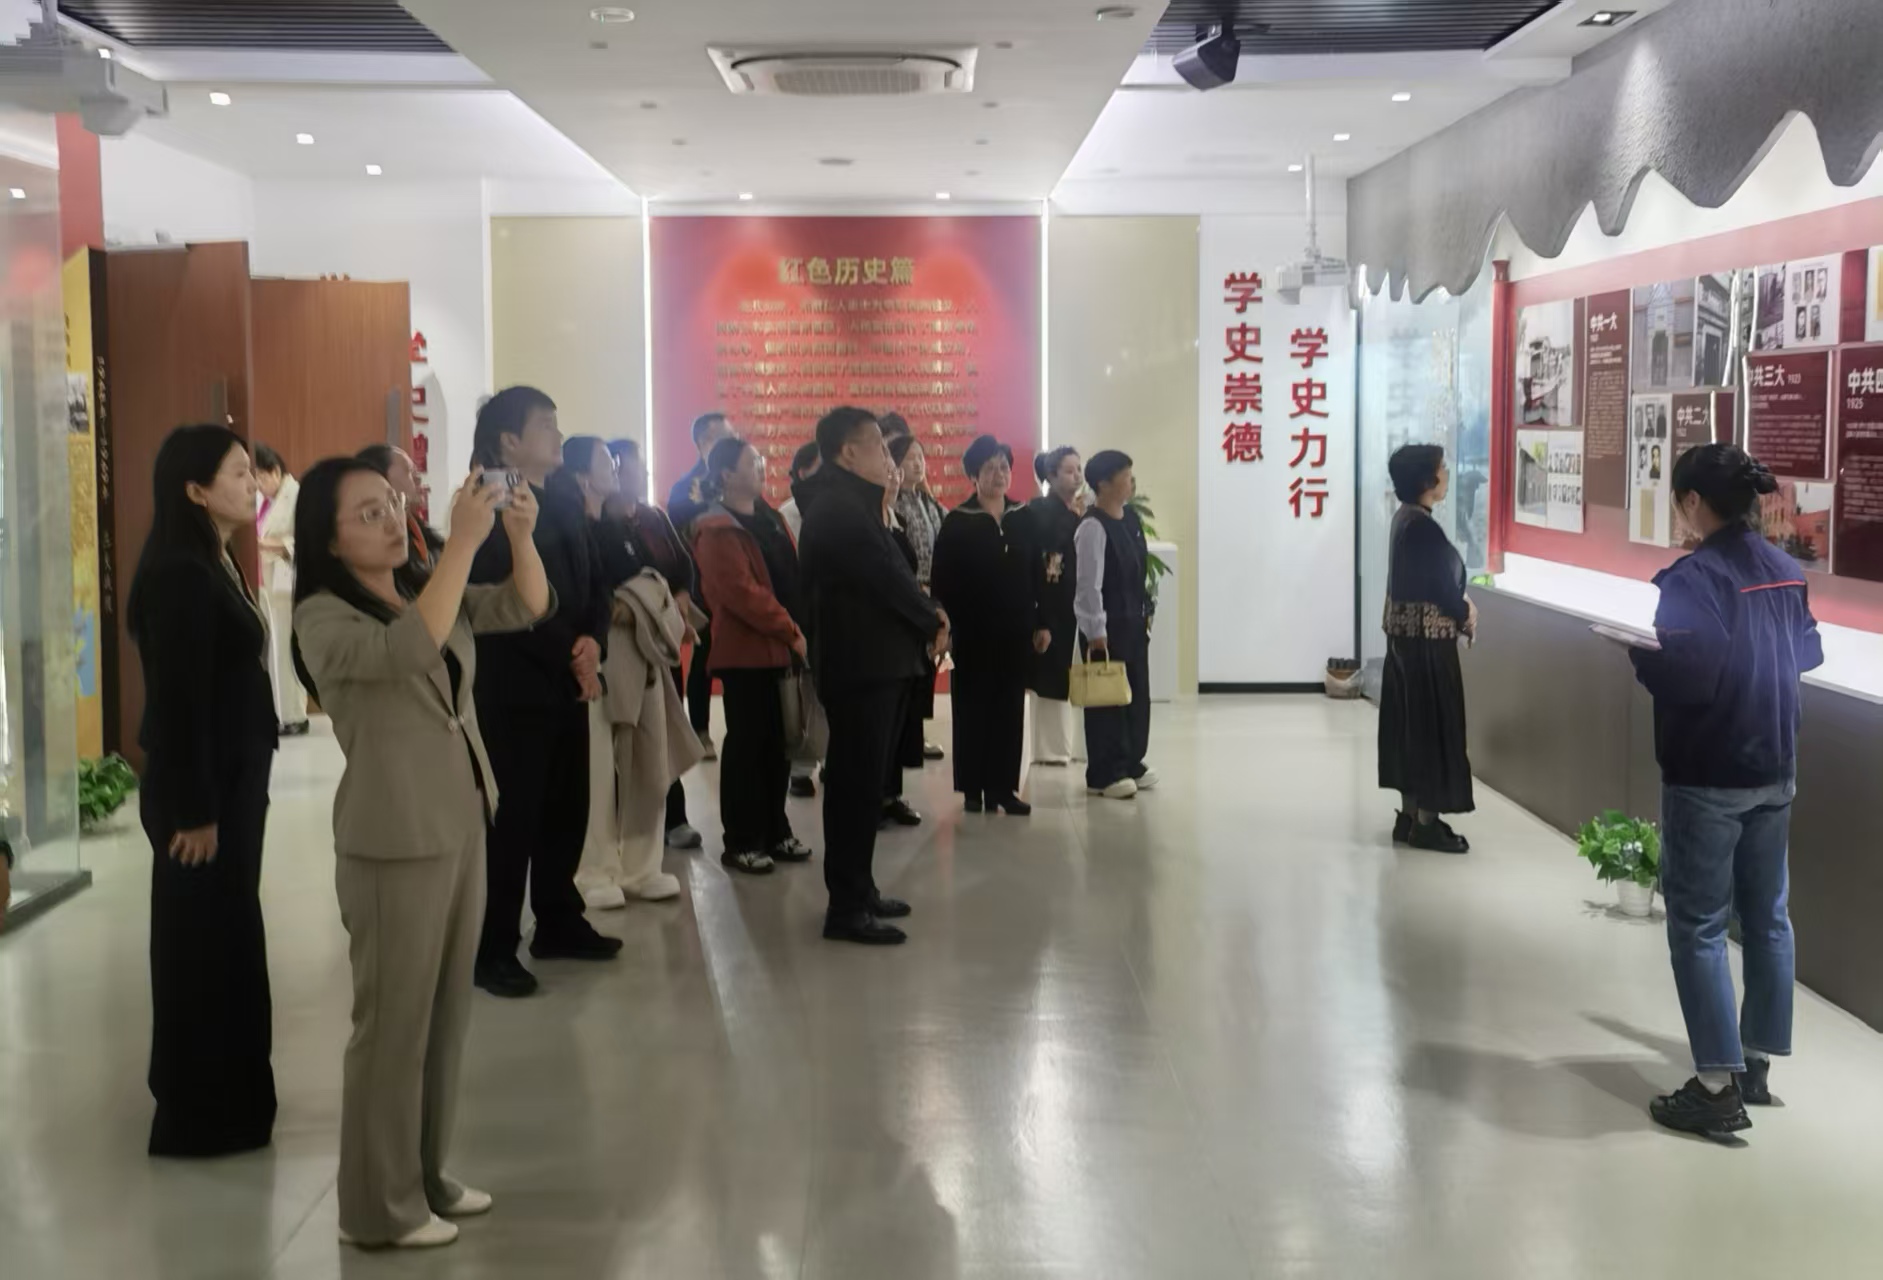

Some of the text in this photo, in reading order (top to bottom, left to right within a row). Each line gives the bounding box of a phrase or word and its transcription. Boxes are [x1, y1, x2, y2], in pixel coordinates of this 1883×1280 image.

[778, 256, 913, 285] 红色历史篇
[1590, 312, 1617, 333] 中共一大
[1223, 271, 1263, 463] 学史崇德
[1288, 327, 1329, 518] 学史力行
